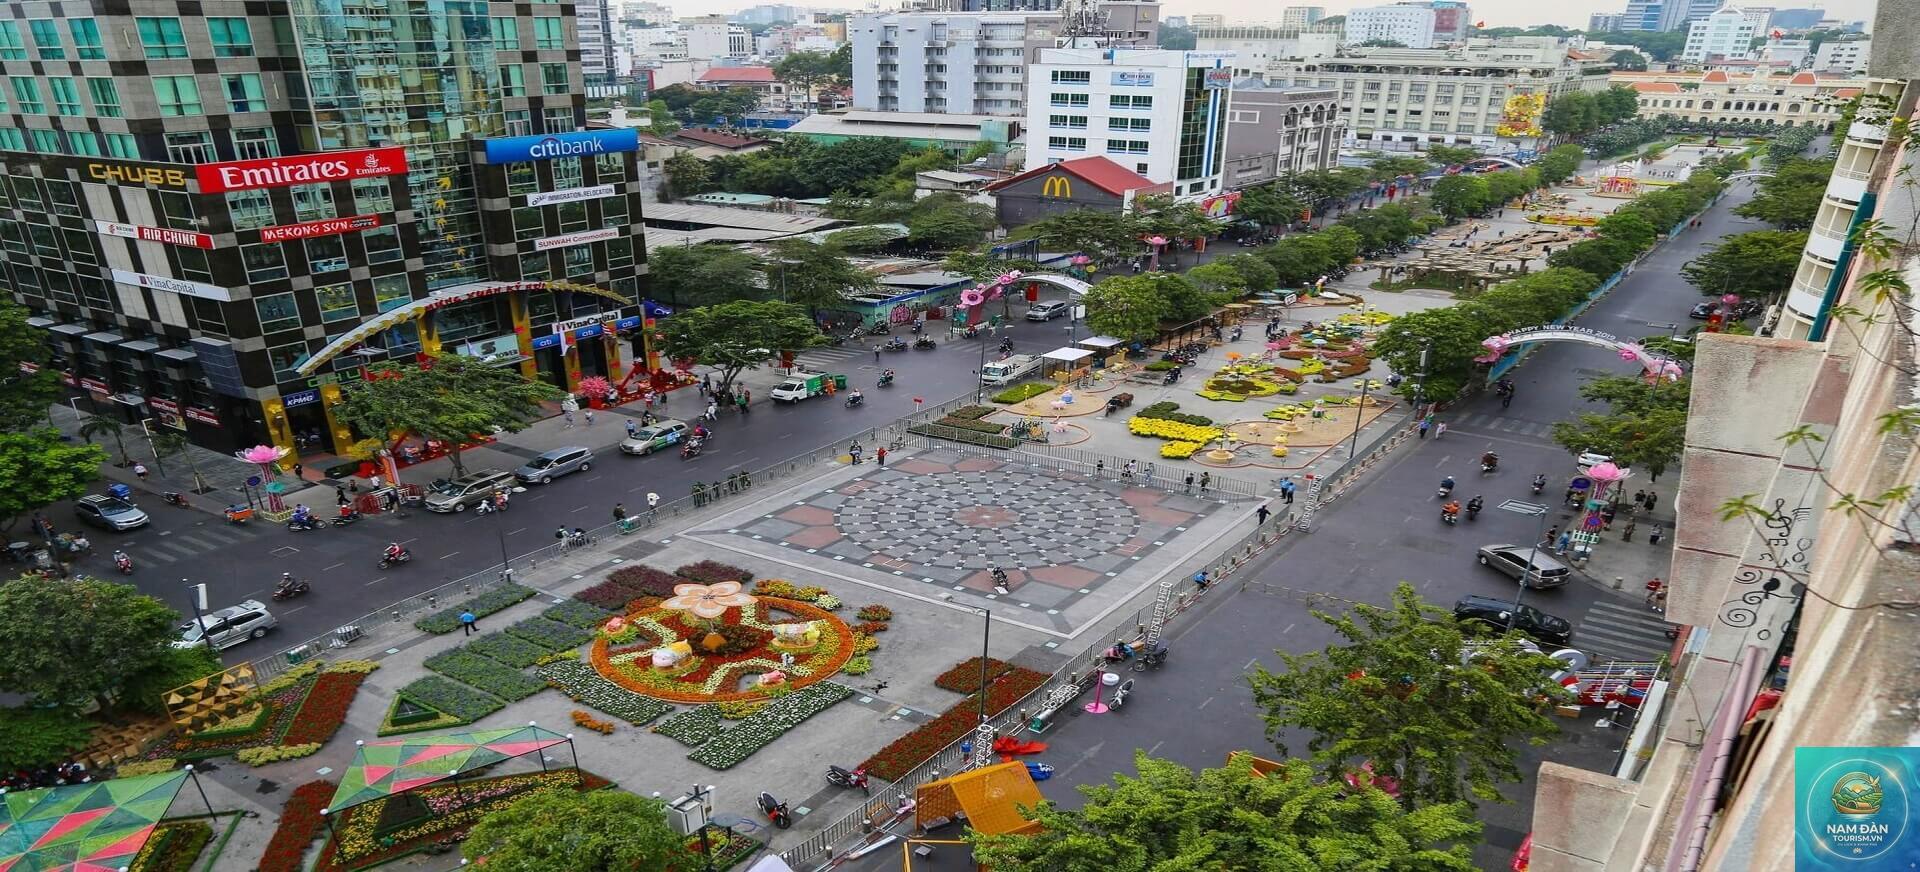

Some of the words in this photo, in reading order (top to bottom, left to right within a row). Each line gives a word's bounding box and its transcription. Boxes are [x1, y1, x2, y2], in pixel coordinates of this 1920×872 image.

[530, 136, 604, 158] citibank
[88, 163, 186, 187] CHUBB
[218, 160, 349, 188] Emirates
[355, 165, 392, 176] Emirates
[583, 187, 614, 198] RELOCATION
[142, 227, 162, 242] AIR
[163, 229, 198, 247] CHINA
[263, 224, 320, 240] MEKONG
[323, 220, 348, 233] SUN
[537, 236, 572, 249] SUNWAH
[572, 230, 617, 243] Commodities
[146, 275, 196, 295] VinaCapital
[582, 329, 594, 337] citi
[1507, 325, 1539, 335] HAPPY
[1567, 325, 1593, 336] YEAR
[1595, 330, 1617, 341] 2019
[540, 339, 552, 347] citi
[287, 395, 314, 406] KPMG
